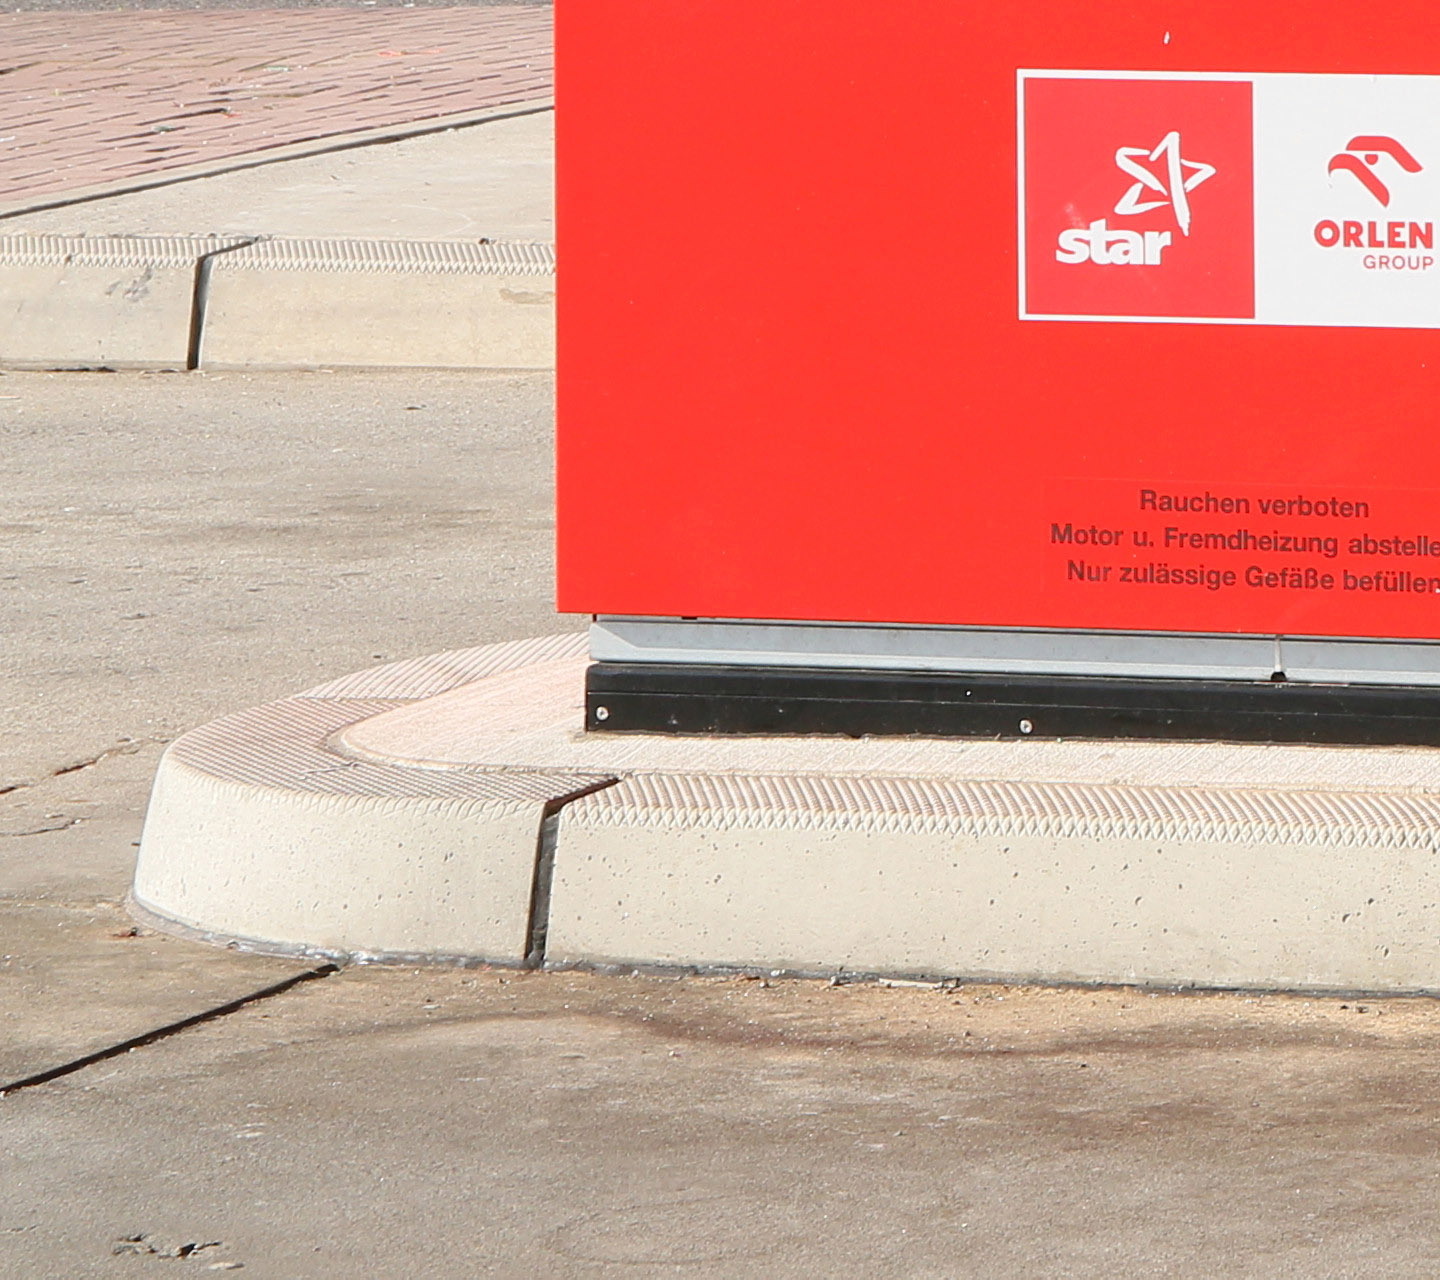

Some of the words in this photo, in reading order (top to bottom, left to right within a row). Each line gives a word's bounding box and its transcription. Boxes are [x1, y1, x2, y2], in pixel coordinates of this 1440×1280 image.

[1055, 218, 1172, 266] star
[1313, 219, 1434, 249] ORLEN
[1362, 254, 1434, 270] GROUP
[1140, 489, 1250, 515] Rauchen
[1258, 495, 1369, 518] verboten
[1051, 523, 1123, 546] Motor
[1133, 530, 1154, 547] u.
[1165, 527, 1339, 558] Fremdheizung
[1067, 560, 1112, 582] Nur
[1119, 563, 1237, 592] zulässige
[1244, 565, 1334, 590] Gefäße
